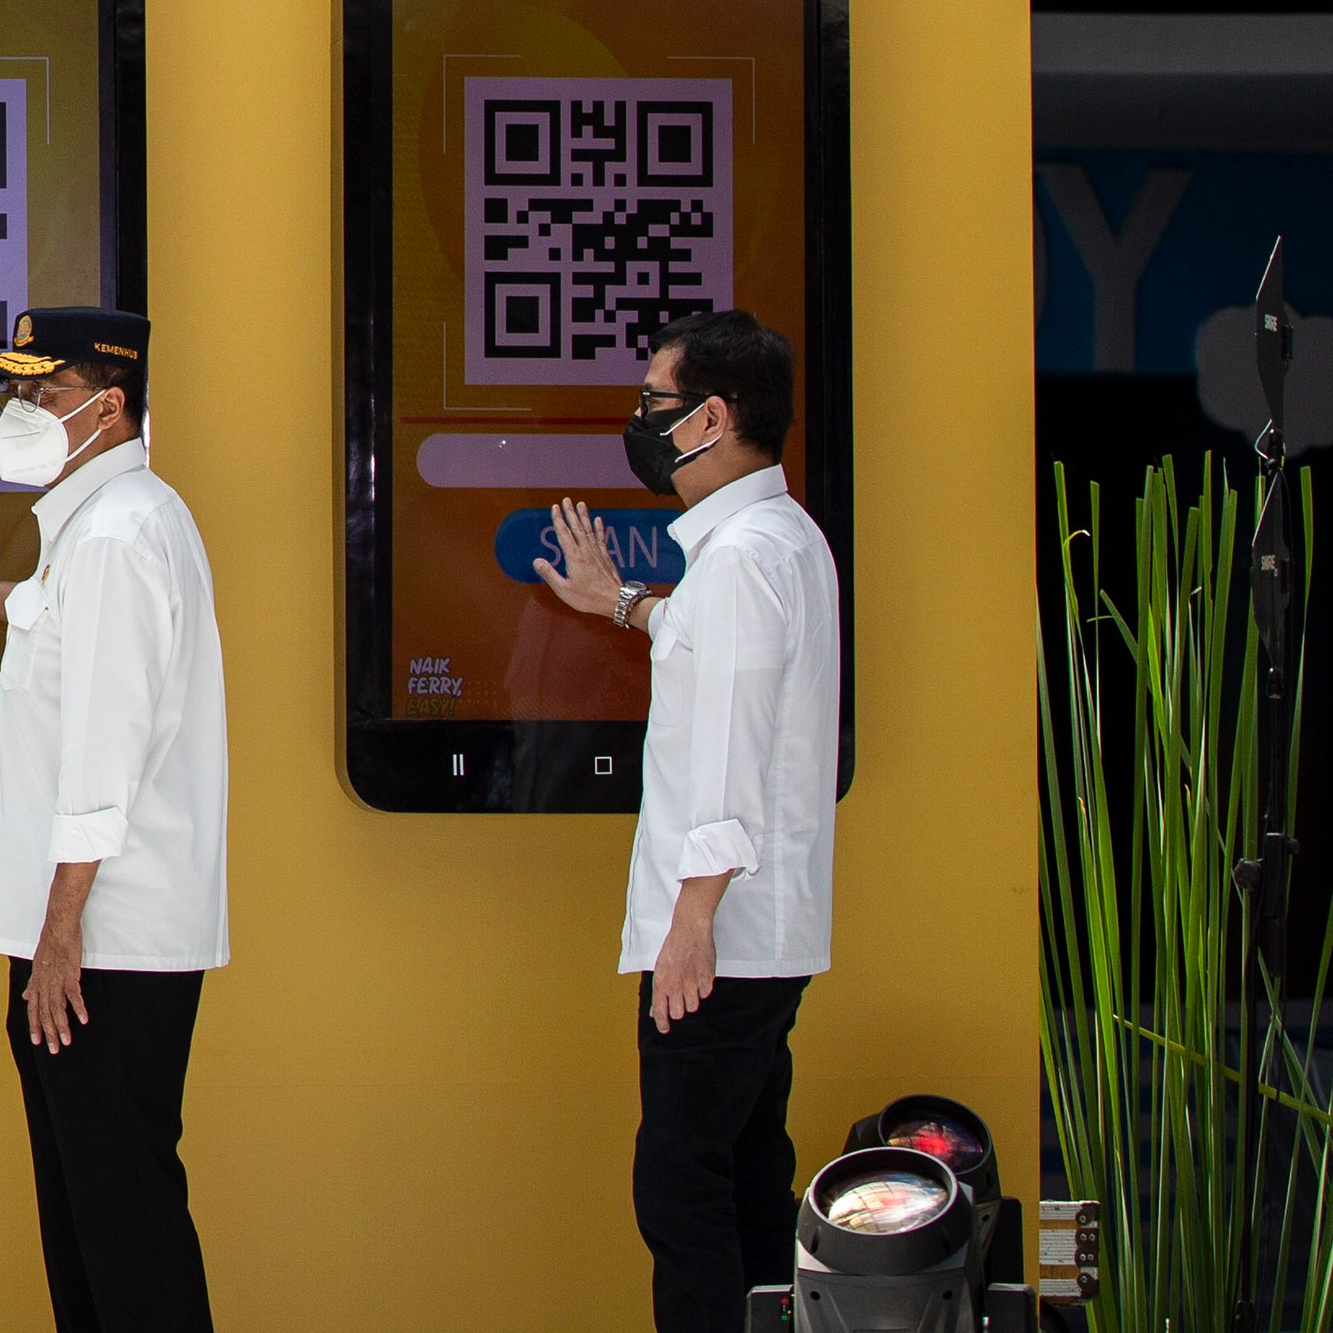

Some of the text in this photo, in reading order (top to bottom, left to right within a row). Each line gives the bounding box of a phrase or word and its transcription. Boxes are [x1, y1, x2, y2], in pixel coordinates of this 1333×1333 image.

[94, 342, 139, 361] KEMENHUB
[538, 525, 659, 569] SAN
[409, 656, 451, 676] NAIK
